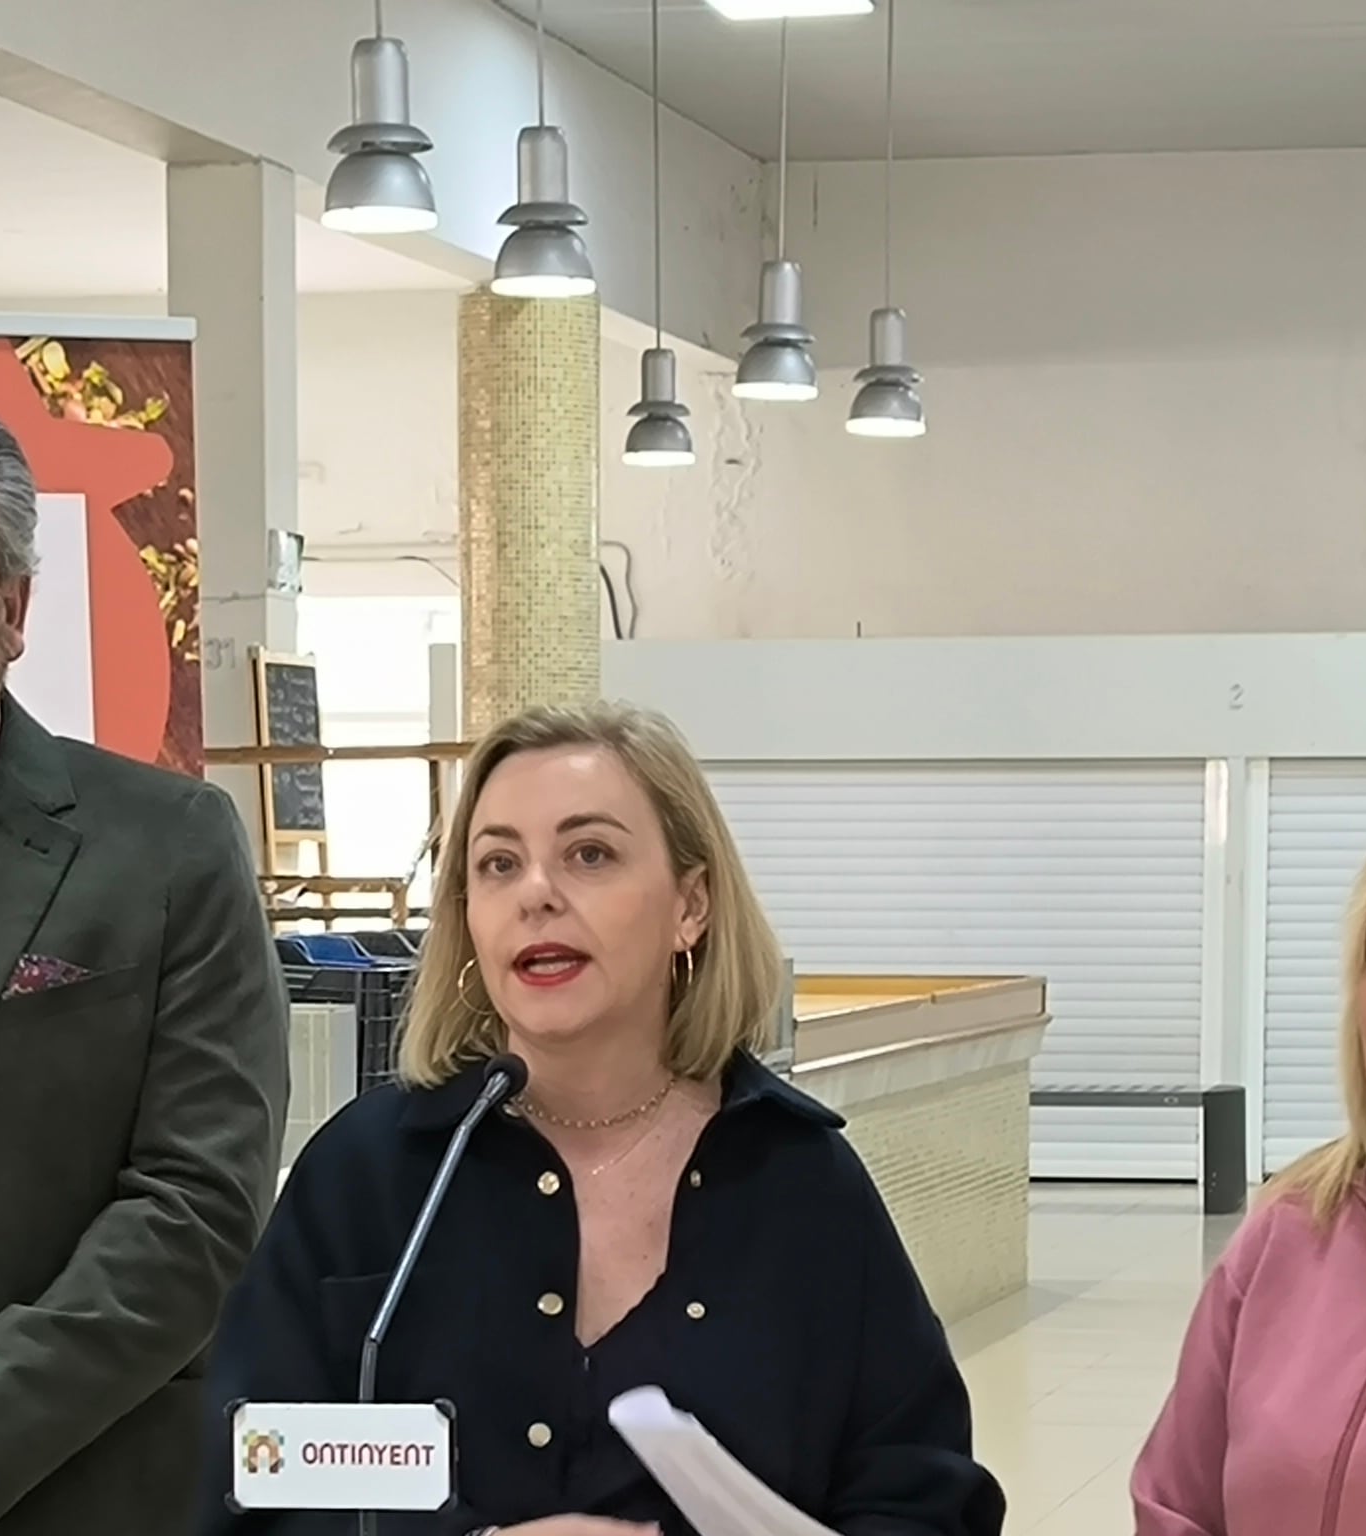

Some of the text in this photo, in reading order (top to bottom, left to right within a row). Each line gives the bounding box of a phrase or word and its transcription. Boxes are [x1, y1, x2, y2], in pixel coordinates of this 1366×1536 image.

[205, 637, 235, 671] 31
[1229, 683, 1244, 710] 2
[301, 1442, 435, 1467] ONTINYENT
